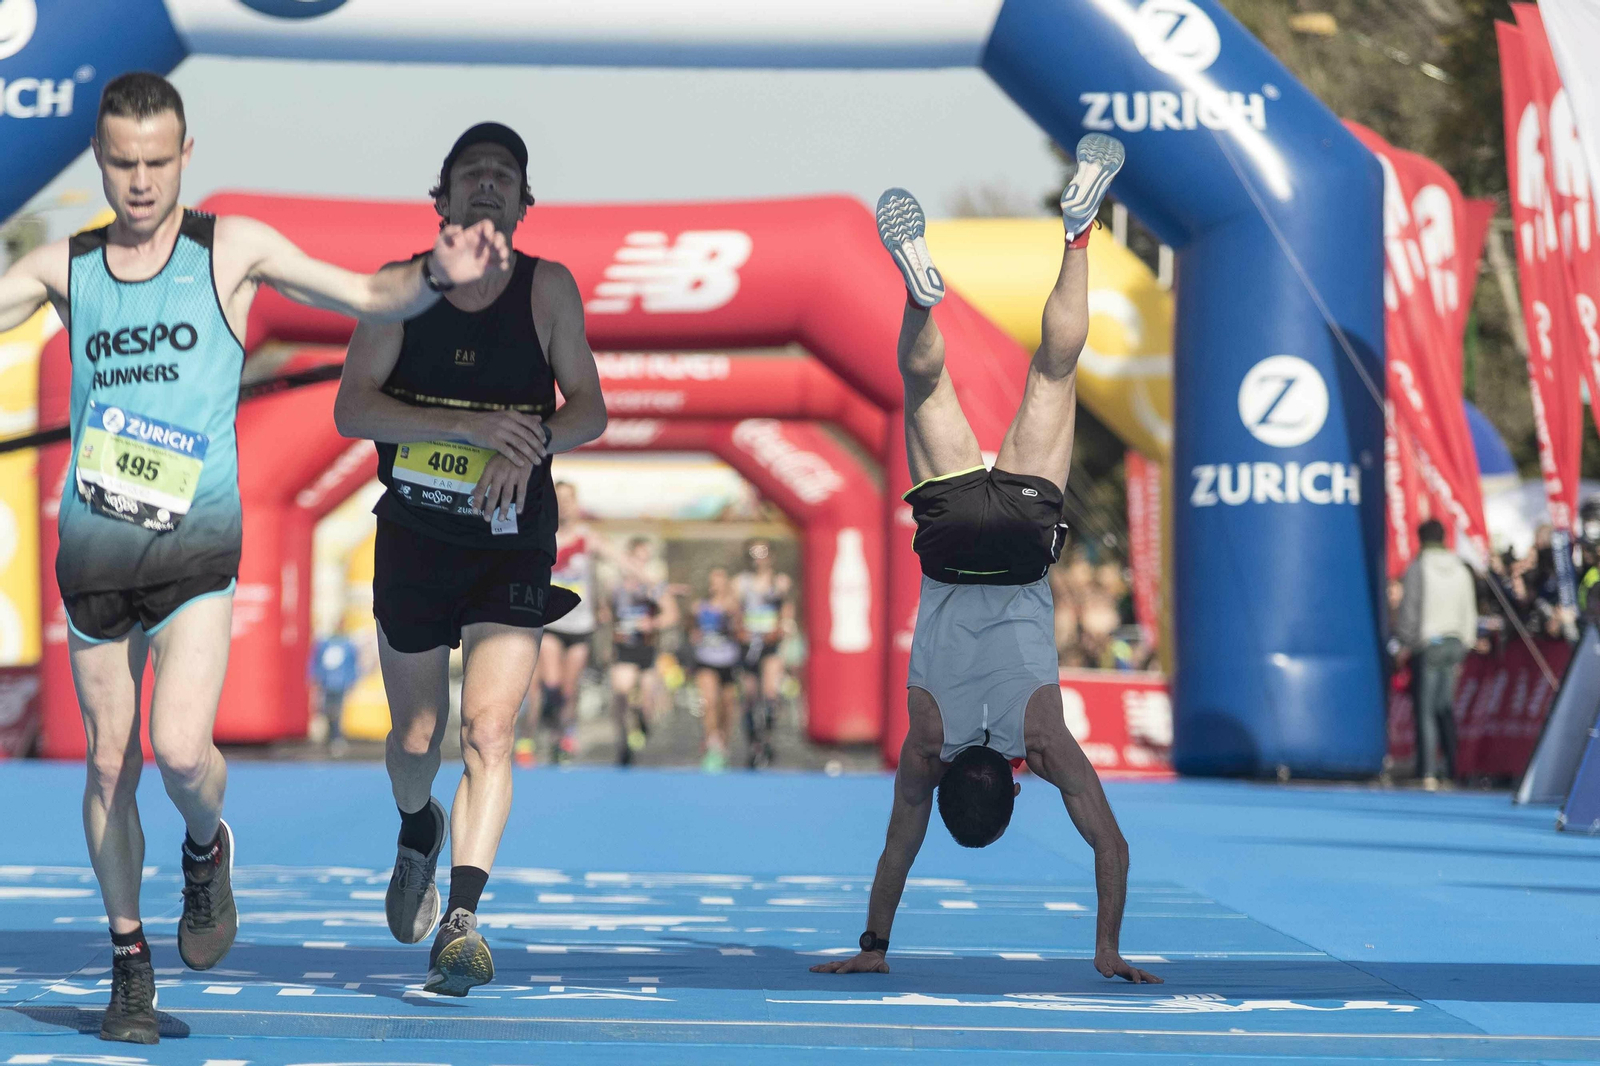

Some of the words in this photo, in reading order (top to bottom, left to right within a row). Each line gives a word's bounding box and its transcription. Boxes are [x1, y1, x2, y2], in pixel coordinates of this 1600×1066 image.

[1081, 91, 1266, 131] ZURICH
[85, 321, 198, 362] CRESPO
[455, 348, 476, 362] FAR
[93, 363, 179, 390] RUNNERS
[126, 419, 194, 452] ZURICH
[116, 452, 160, 481] 495
[428, 451, 469, 475] 408
[433, 478, 453, 489] FAR
[1191, 460, 1361, 507] ZURICH
[509, 583, 545, 607] FAR
